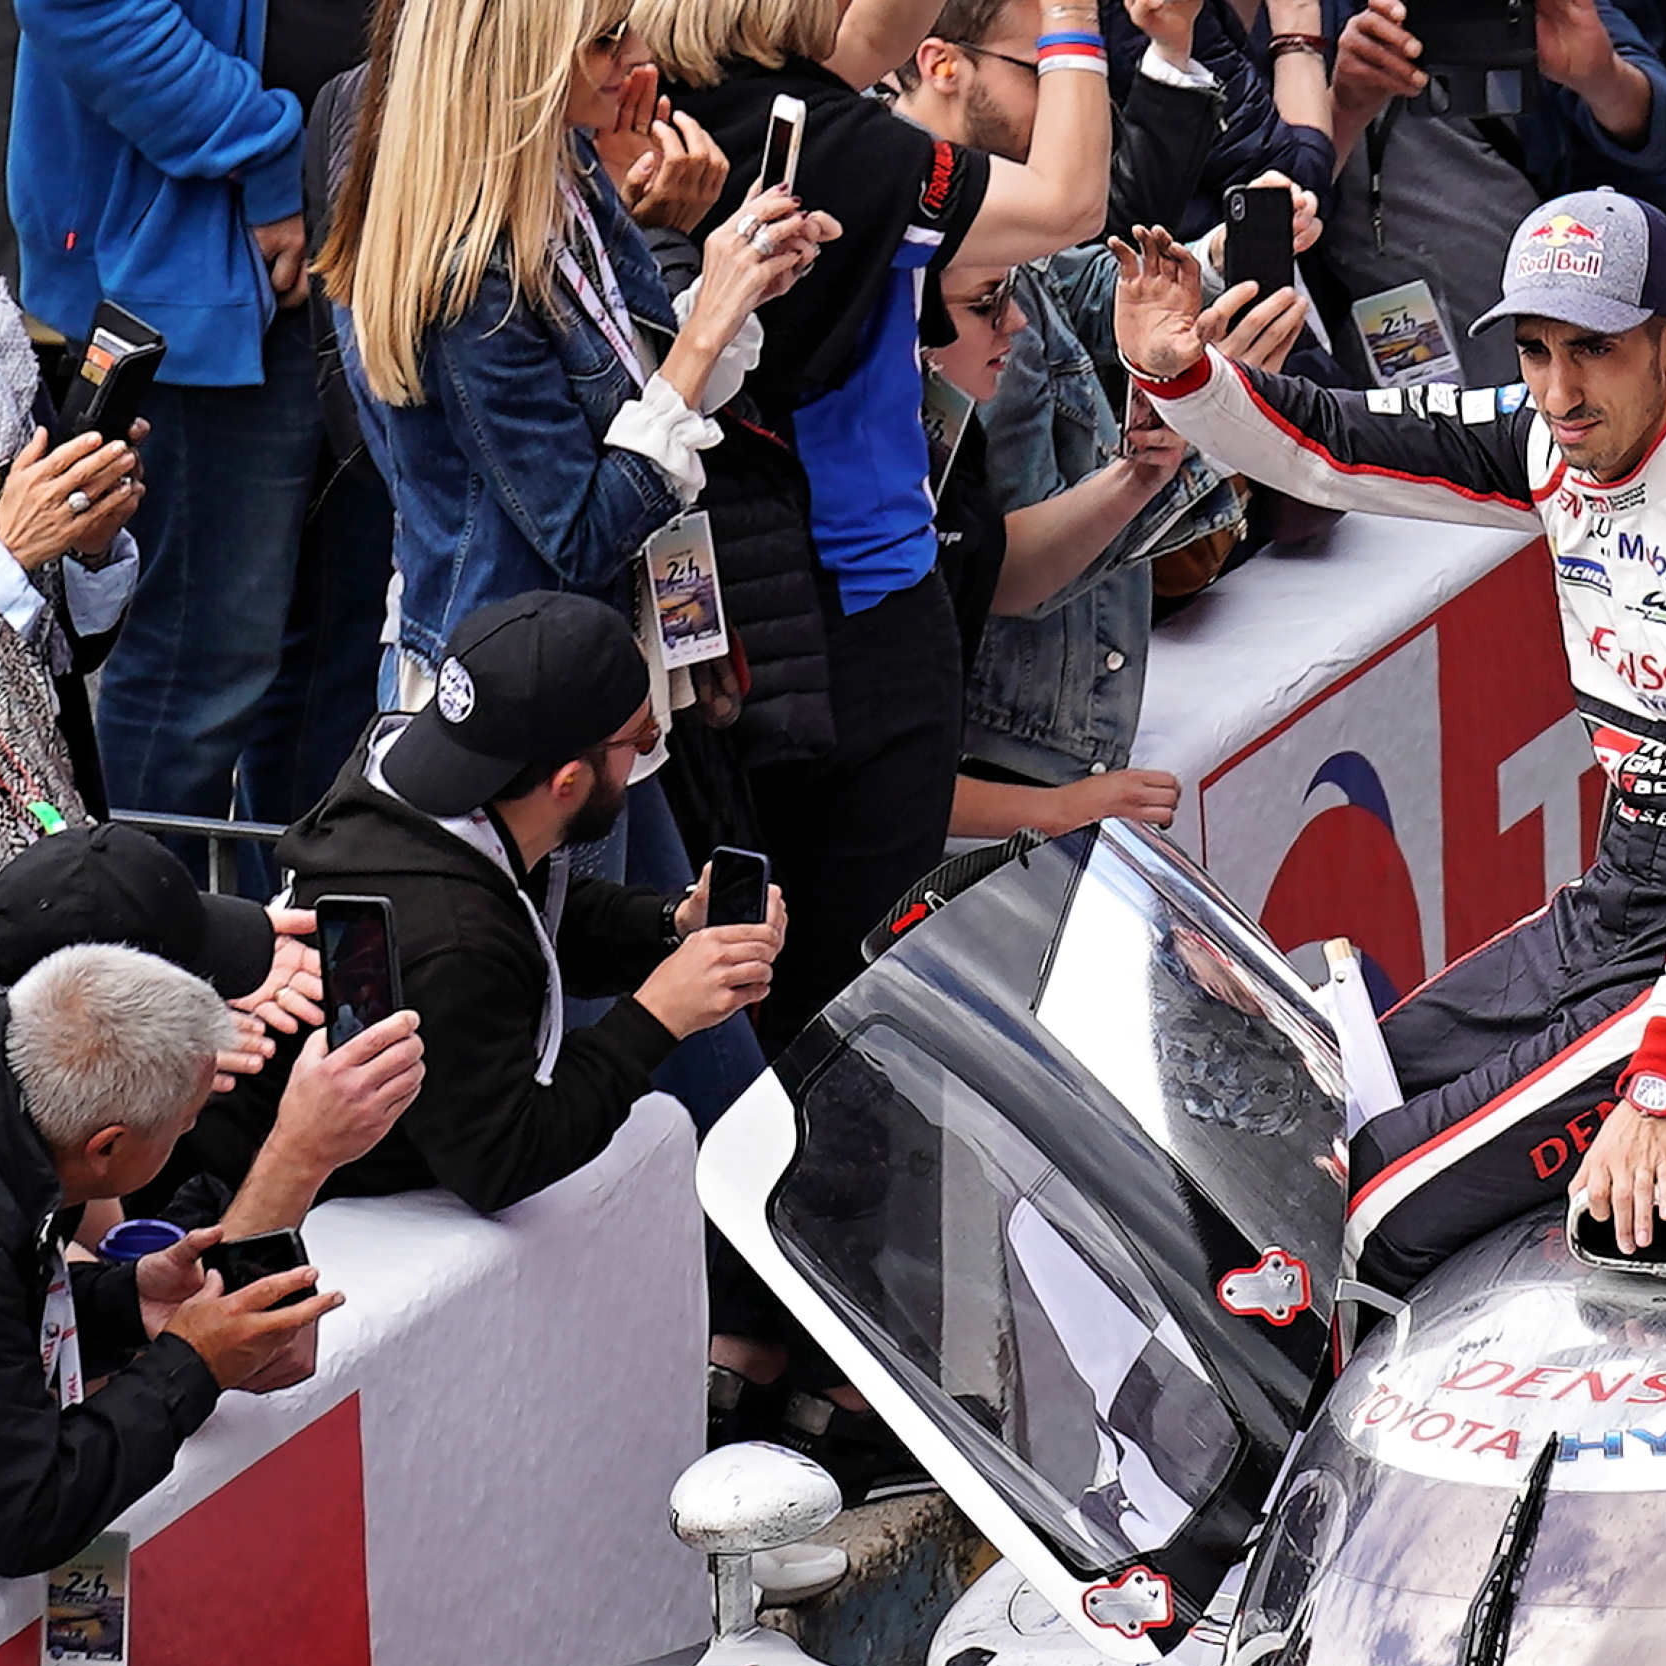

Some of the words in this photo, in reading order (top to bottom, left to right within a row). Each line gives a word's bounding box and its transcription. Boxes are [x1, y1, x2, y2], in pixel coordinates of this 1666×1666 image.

[1517, 250, 1551, 275] Red
[1556, 251, 1601, 276] Bull
[1367, 1383, 1533, 1461] TOYOTA
